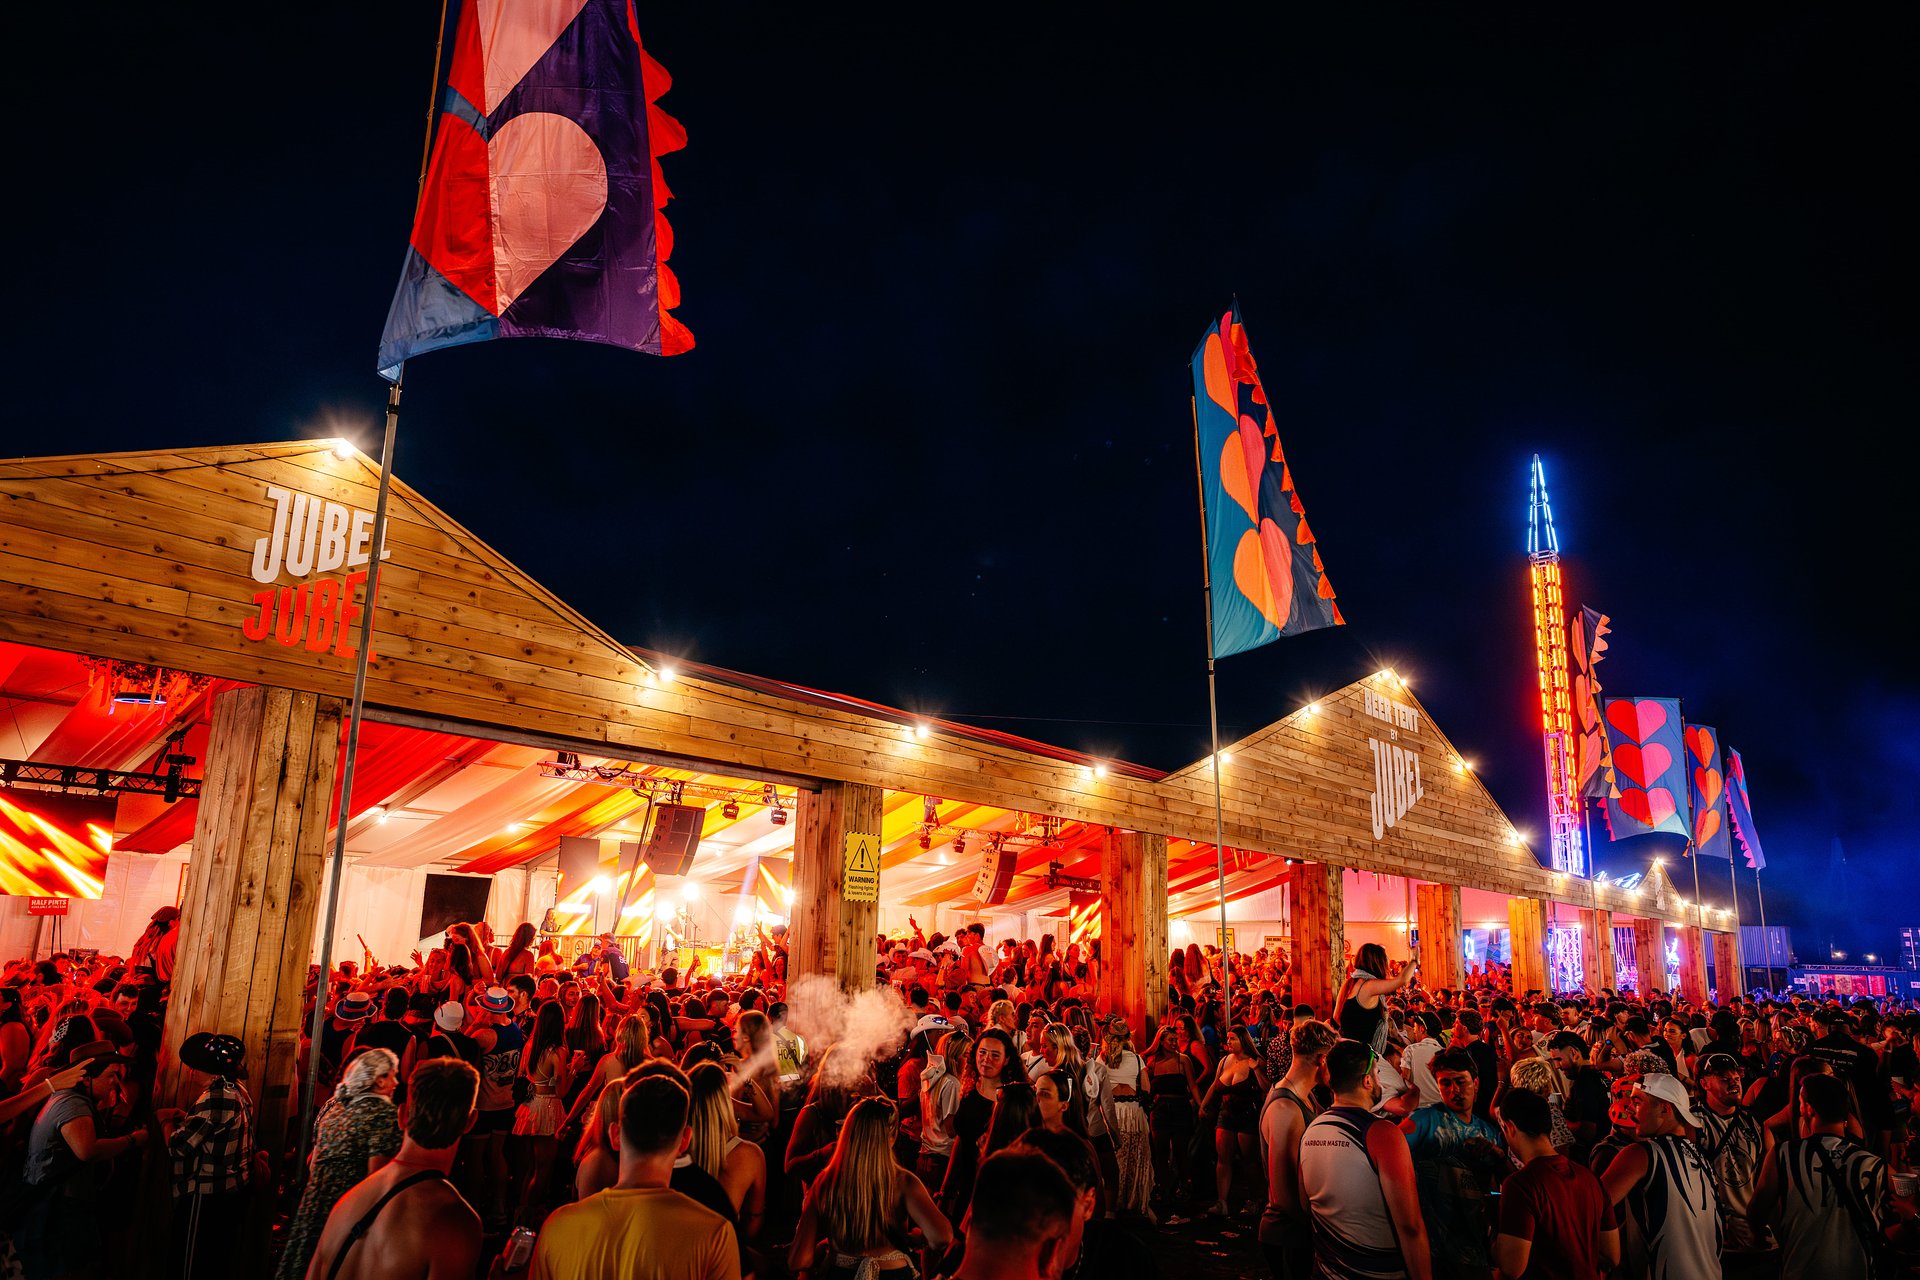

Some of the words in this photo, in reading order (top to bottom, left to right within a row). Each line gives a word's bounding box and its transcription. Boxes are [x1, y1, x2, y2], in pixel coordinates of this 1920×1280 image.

[1363, 689, 1392, 723] BEER
[1393, 701, 1419, 733] TENT
[1390, 729, 1398, 741] BY
[1369, 737, 1424, 840] JUBEL
[848, 876, 875, 884] WARNING
[1327, 1140, 1350, 1148] MASTER
